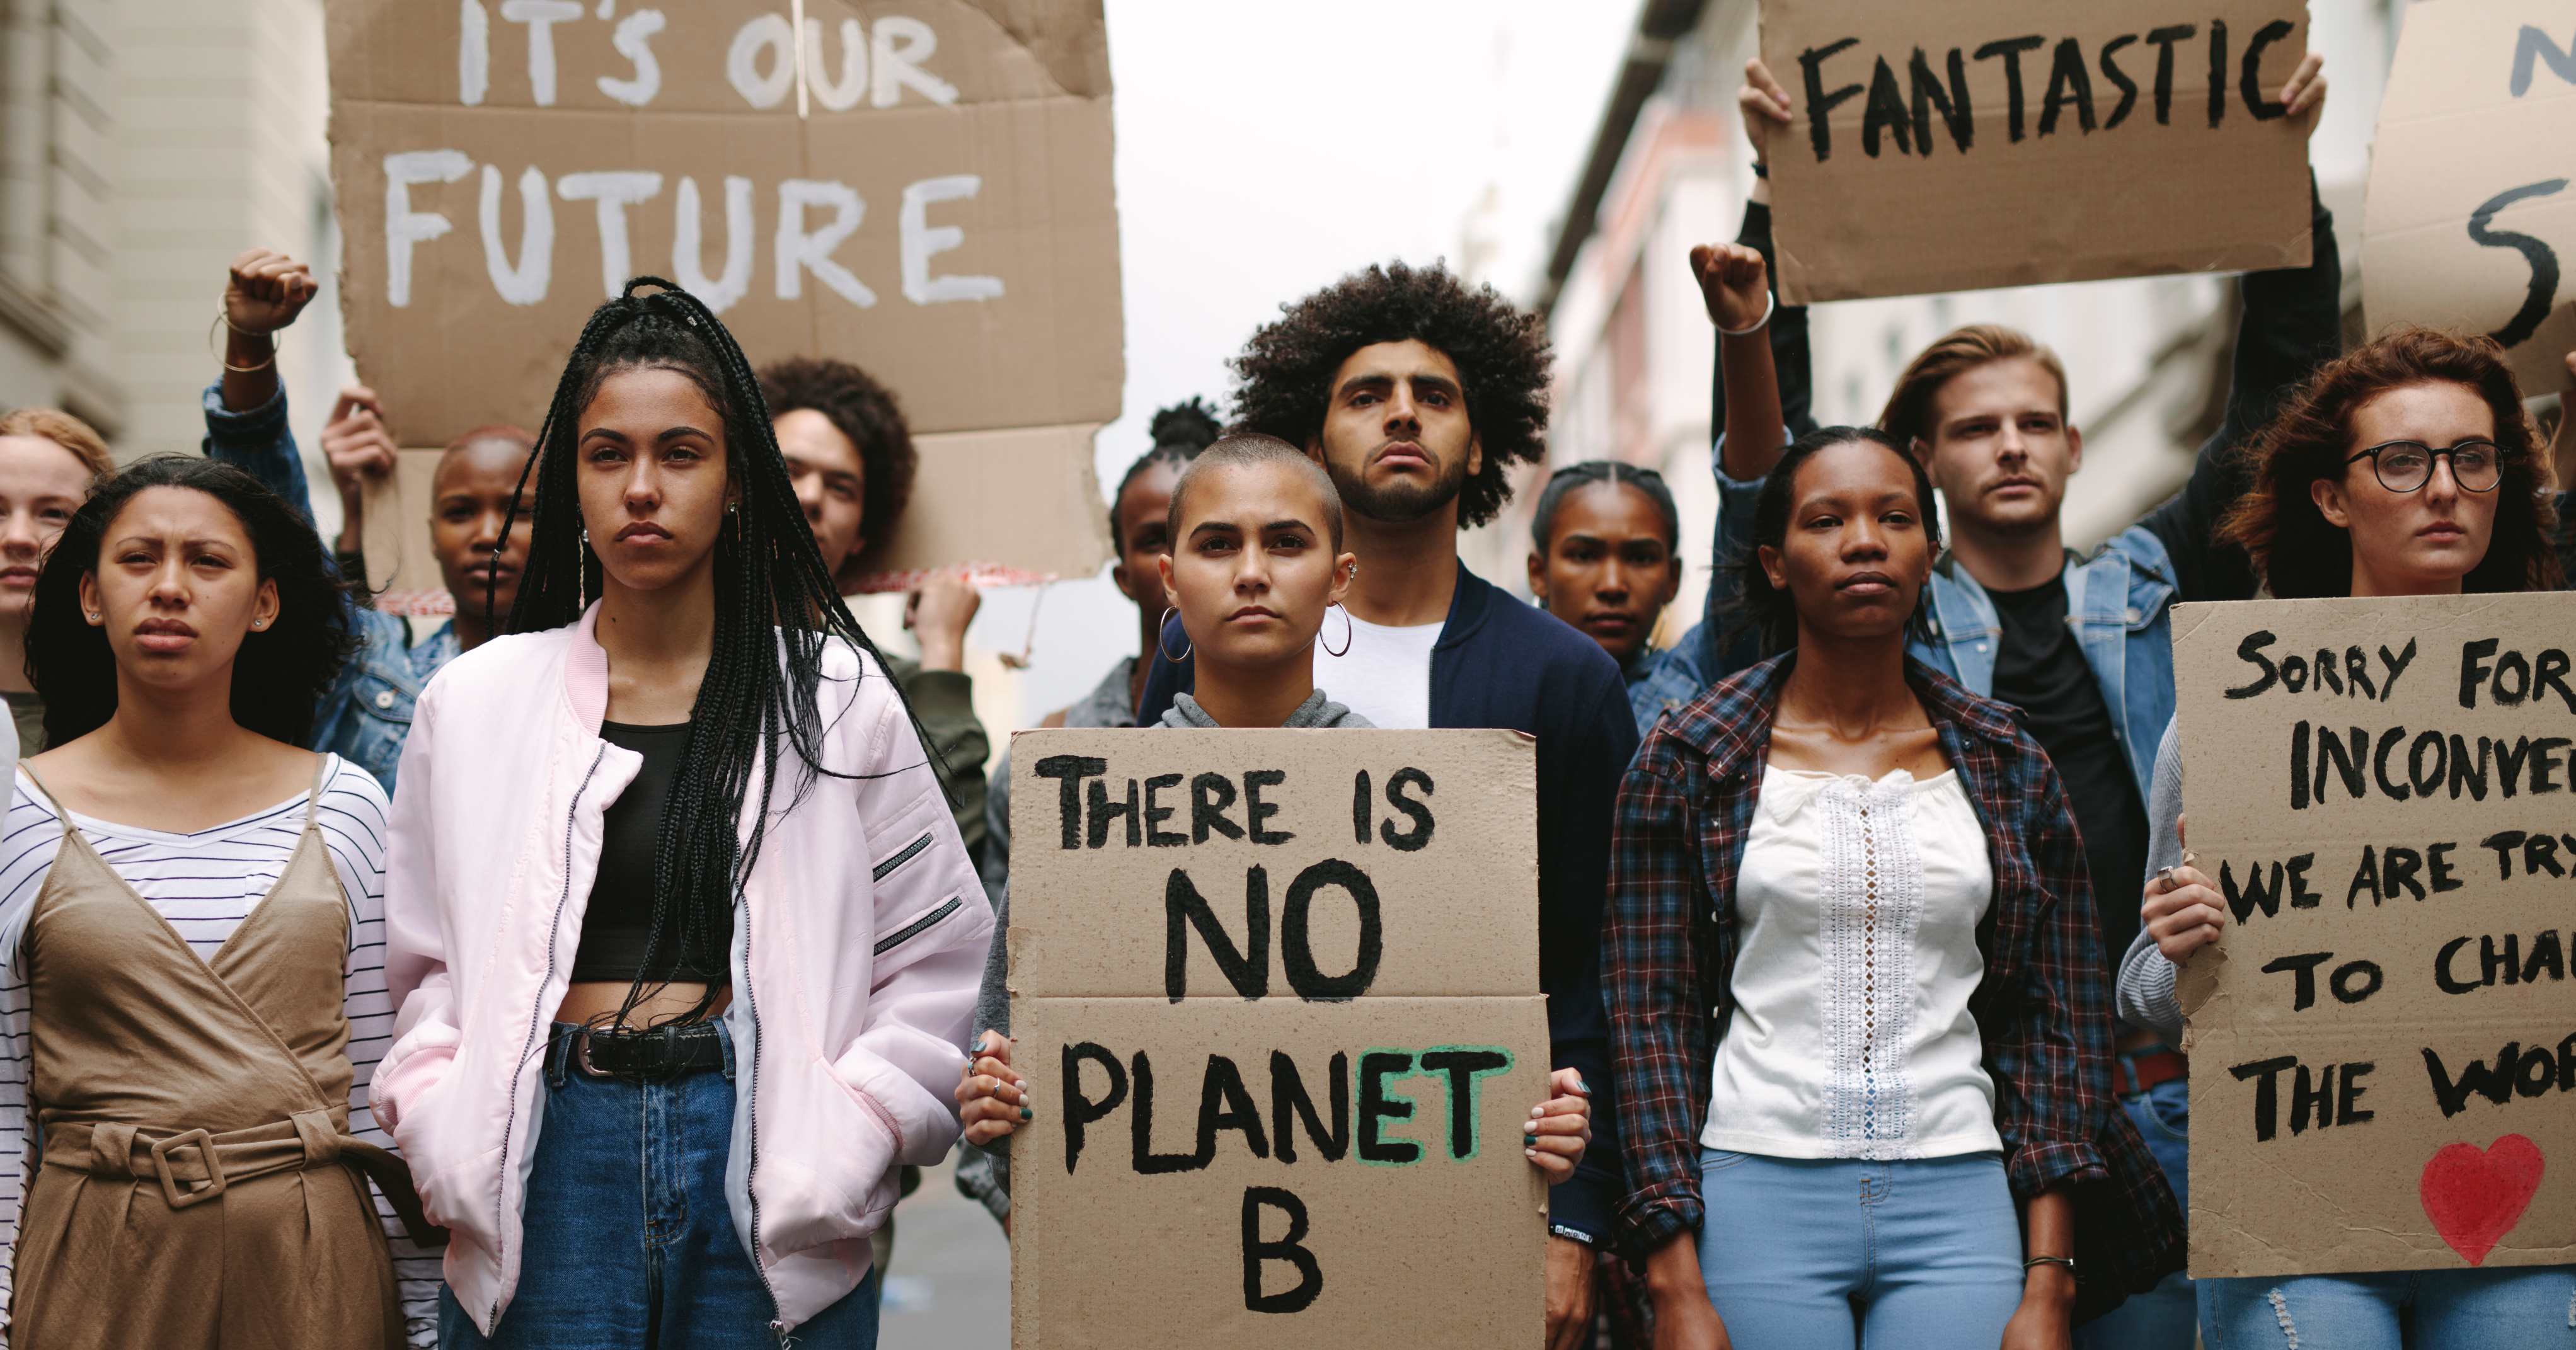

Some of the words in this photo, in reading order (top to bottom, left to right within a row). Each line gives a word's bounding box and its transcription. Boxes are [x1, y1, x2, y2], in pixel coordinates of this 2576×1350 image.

[459, 0, 665, 106] IT'S
[725, 13, 958, 110] OUR
[1798, 19, 2295, 162] FANTASTIC
[383, 149, 1004, 314] FUTURE
[2224, 630, 2417, 702] SORRY
[2459, 638, 2576, 715] FOR
[1034, 755, 1296, 850] THERE
[1353, 767, 1435, 852] IS
[2291, 720, 2576, 810] INCONVE
[1164, 857, 1383, 1004] NO
[2219, 852, 2323, 926] WE
[2347, 842, 2464, 911] ARE
[2261, 951, 2384, 1012] TO
[2434, 929, 2576, 994] CHA
[1062, 1041, 1514, 1176] PLANET
[2228, 1055, 2376, 1143] THE
[1241, 1186, 1324, 1313] B
